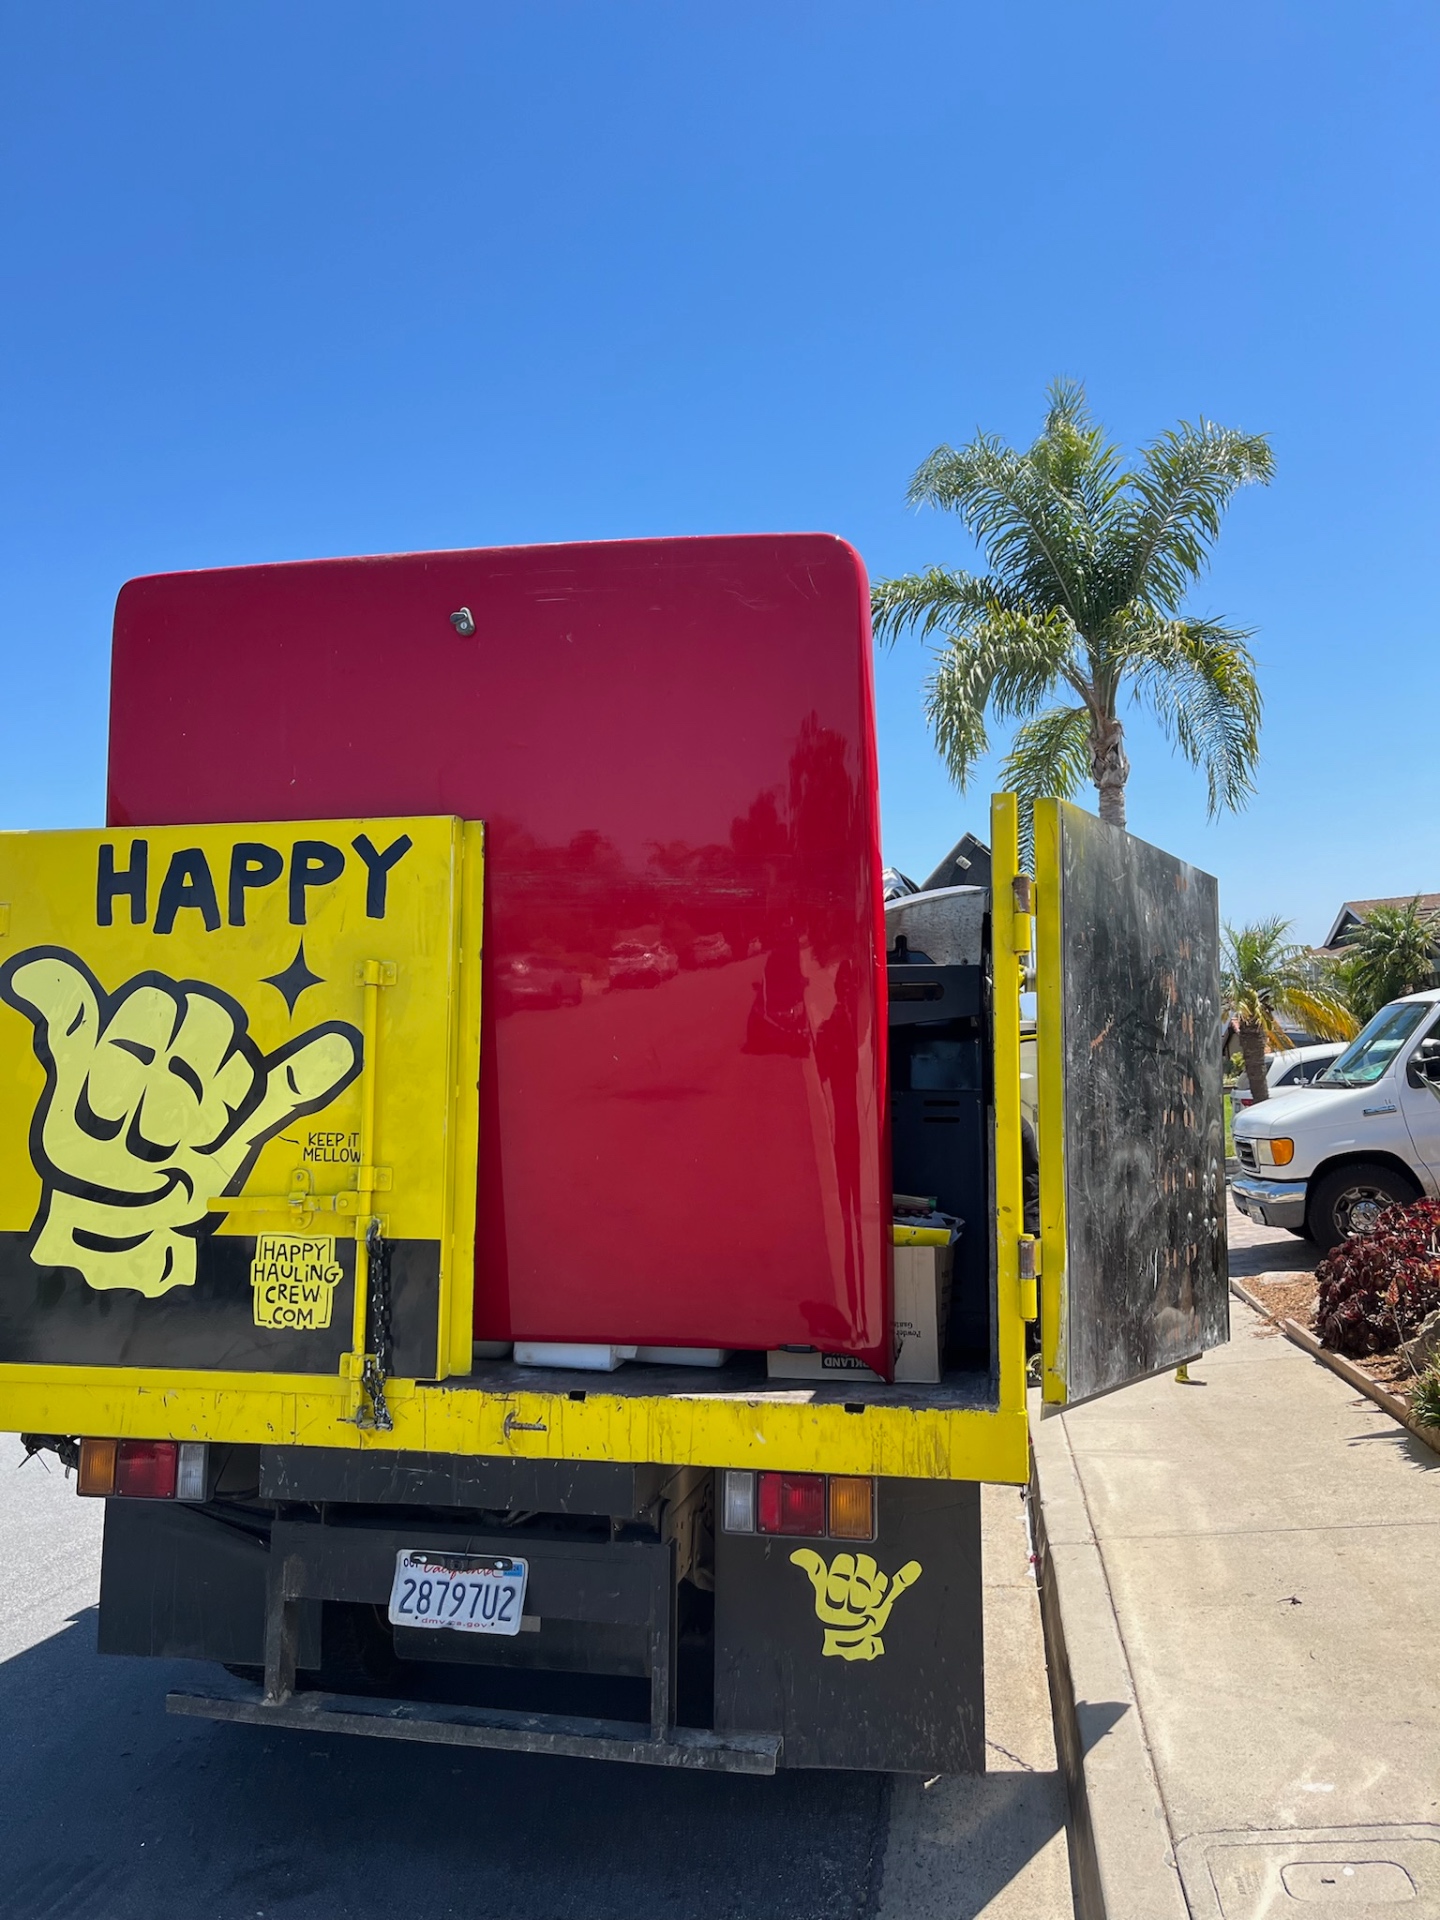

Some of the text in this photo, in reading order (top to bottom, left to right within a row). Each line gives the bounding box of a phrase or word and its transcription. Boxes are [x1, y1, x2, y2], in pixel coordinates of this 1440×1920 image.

[96, 832, 413, 935] HAPPY
[308, 1132, 345, 1147] KEEP
[303, 1147, 361, 1163] MELLOW
[263, 1241, 326, 1263] HAPPY
[265, 1284, 320, 1304] CREW
[267, 1307, 313, 1326] .COM
[398, 1579, 516, 1622] 28797U2
